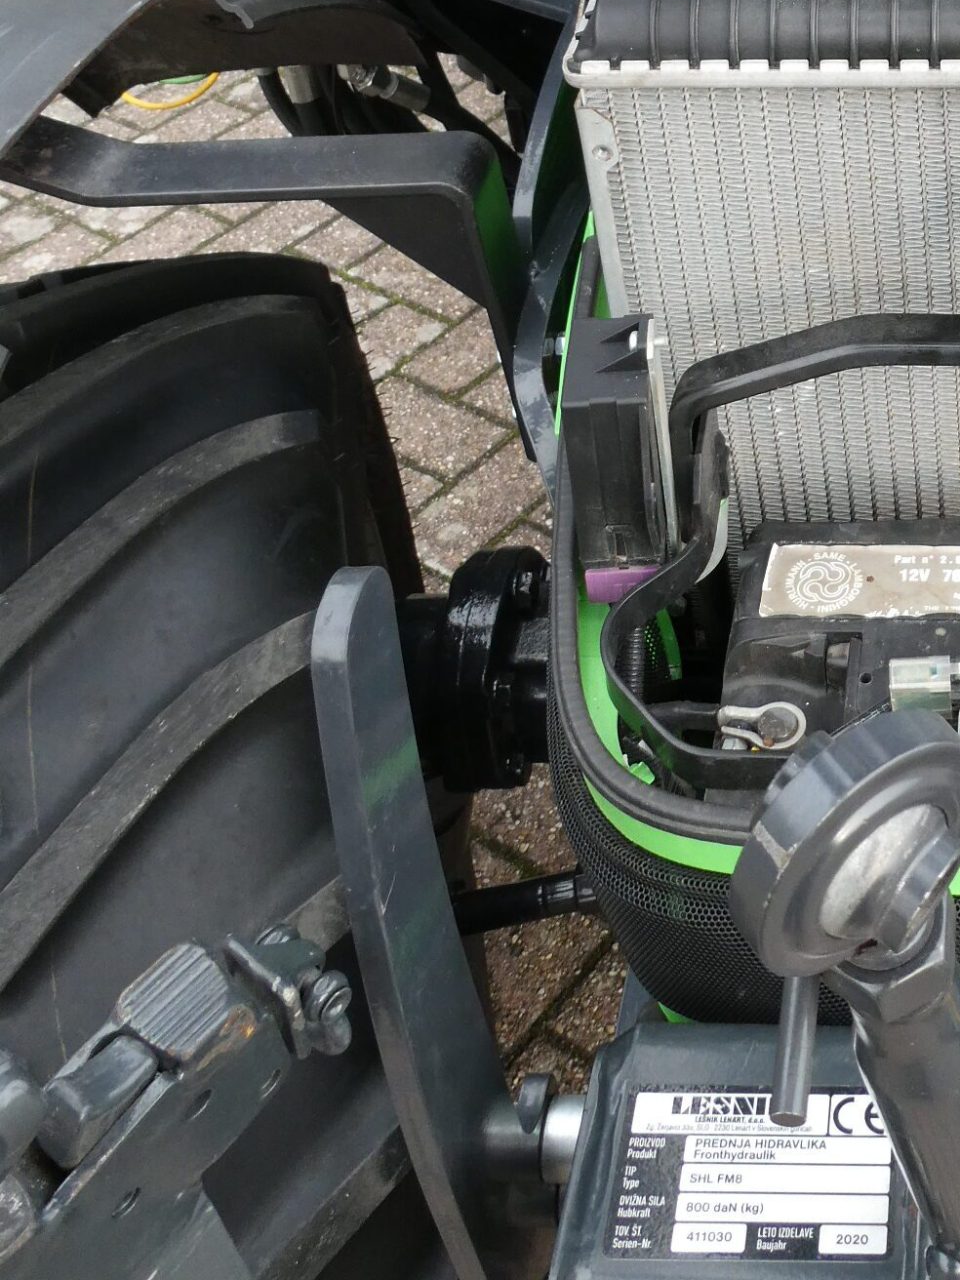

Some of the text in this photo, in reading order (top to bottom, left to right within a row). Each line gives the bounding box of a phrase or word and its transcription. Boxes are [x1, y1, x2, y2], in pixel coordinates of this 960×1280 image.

[813, 551, 847, 562] SAME
[899, 568, 931, 583] 12V
[817, 562, 863, 613] LAMBORGHINI
[672, 1096, 769, 1115] LESNI
[629, 1137, 666, 1148] PROIZVOD
[695, 1138, 827, 1150] PREDNJA HIDRAVLIKA
[627, 1148, 657, 1159] Produkt
[693, 1149, 776, 1161] Fronthydraulik
[625, 1165, 637, 1176] TIP
[623, 1177, 640, 1190] Type
[689, 1173, 743, 1184] SHL FM8
[648, 1195, 666, 1207] SILA
[617, 1207, 651, 1218] Hubkraft
[686, 1202, 764, 1215] 800 daN (kg)
[686, 1231, 733, 1242] 411030
[757, 1226, 814, 1239] LETO IZDELAVE
[836, 1234, 869, 1245] 2020
[756, 1239, 787, 1253] Baujahr
